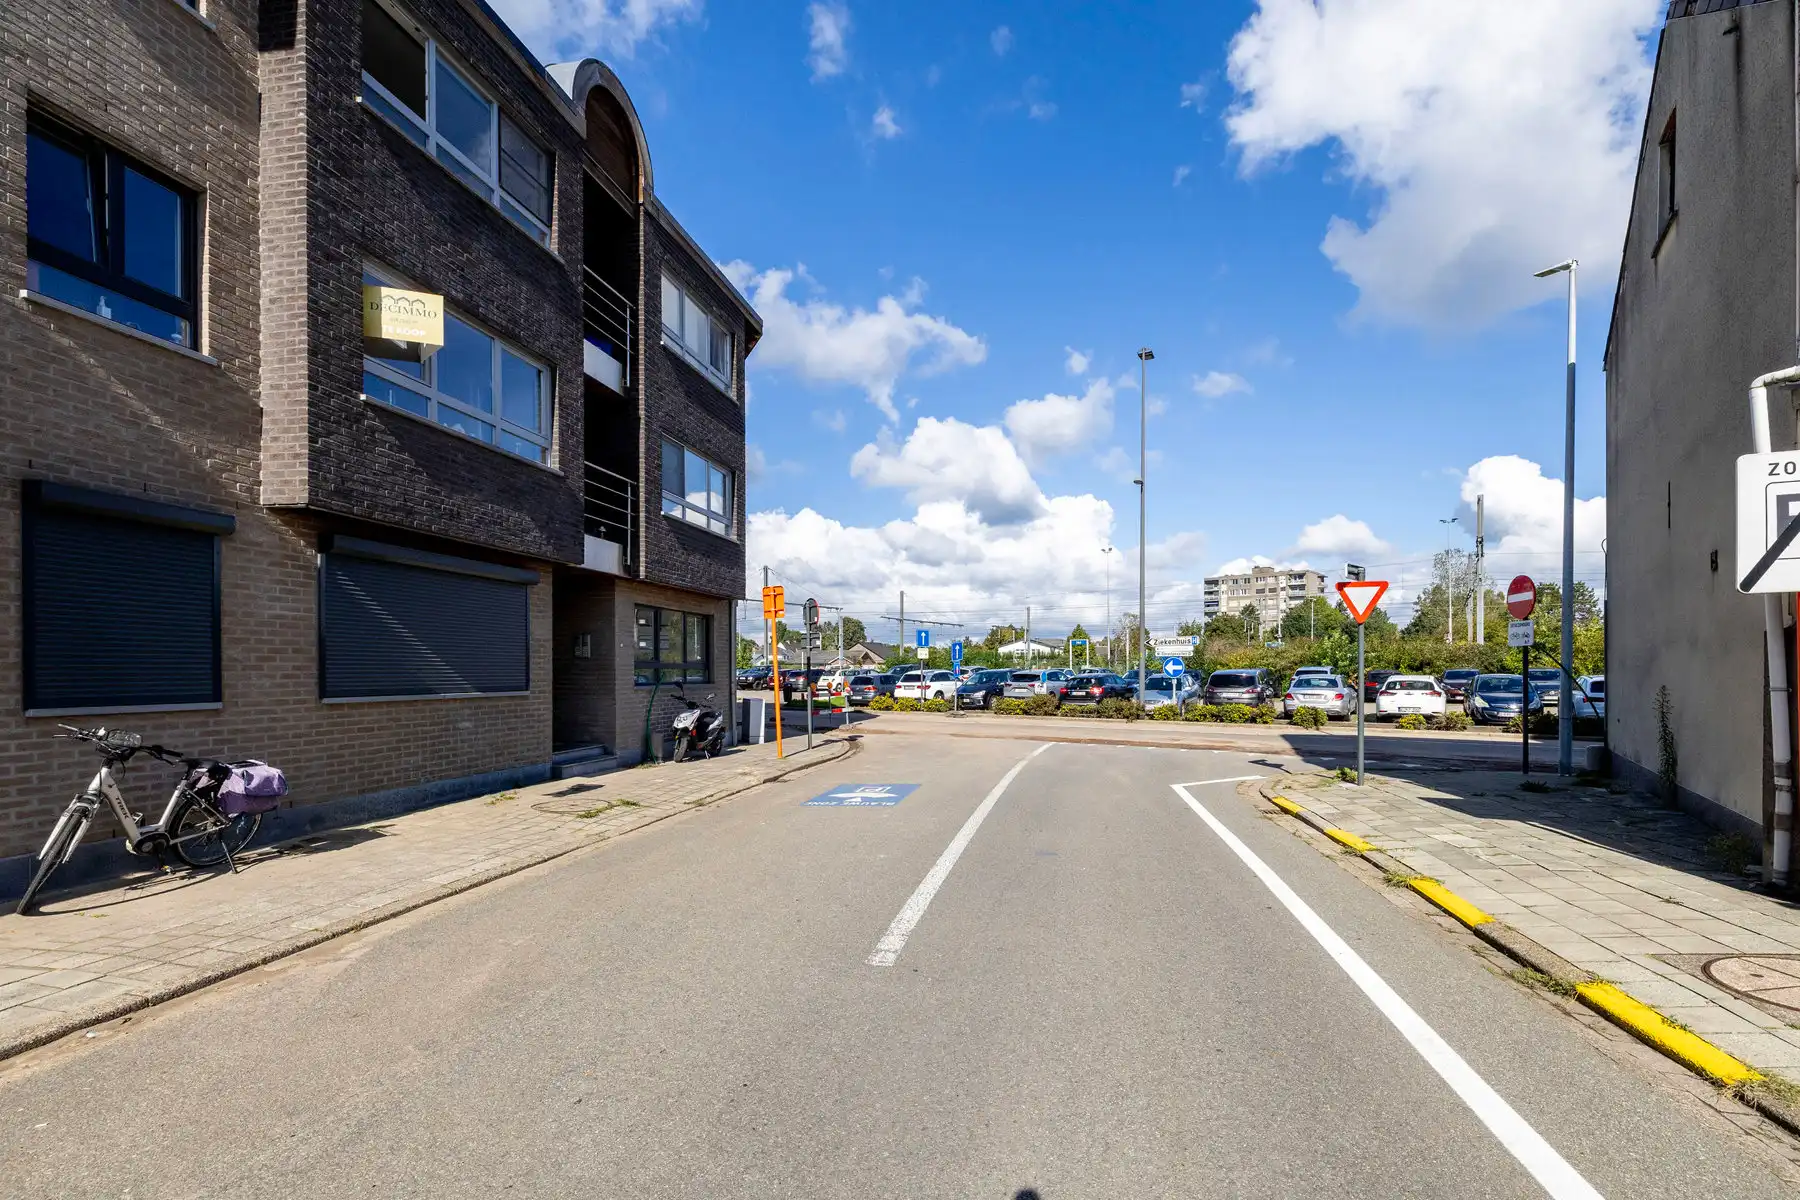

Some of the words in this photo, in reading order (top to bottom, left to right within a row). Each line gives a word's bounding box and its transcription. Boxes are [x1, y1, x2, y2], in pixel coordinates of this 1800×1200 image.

[370, 301, 437, 318] DECIMMO
[1153, 638, 1191, 646] Ziekenhuis
[115, 796, 130, 819] TREK
